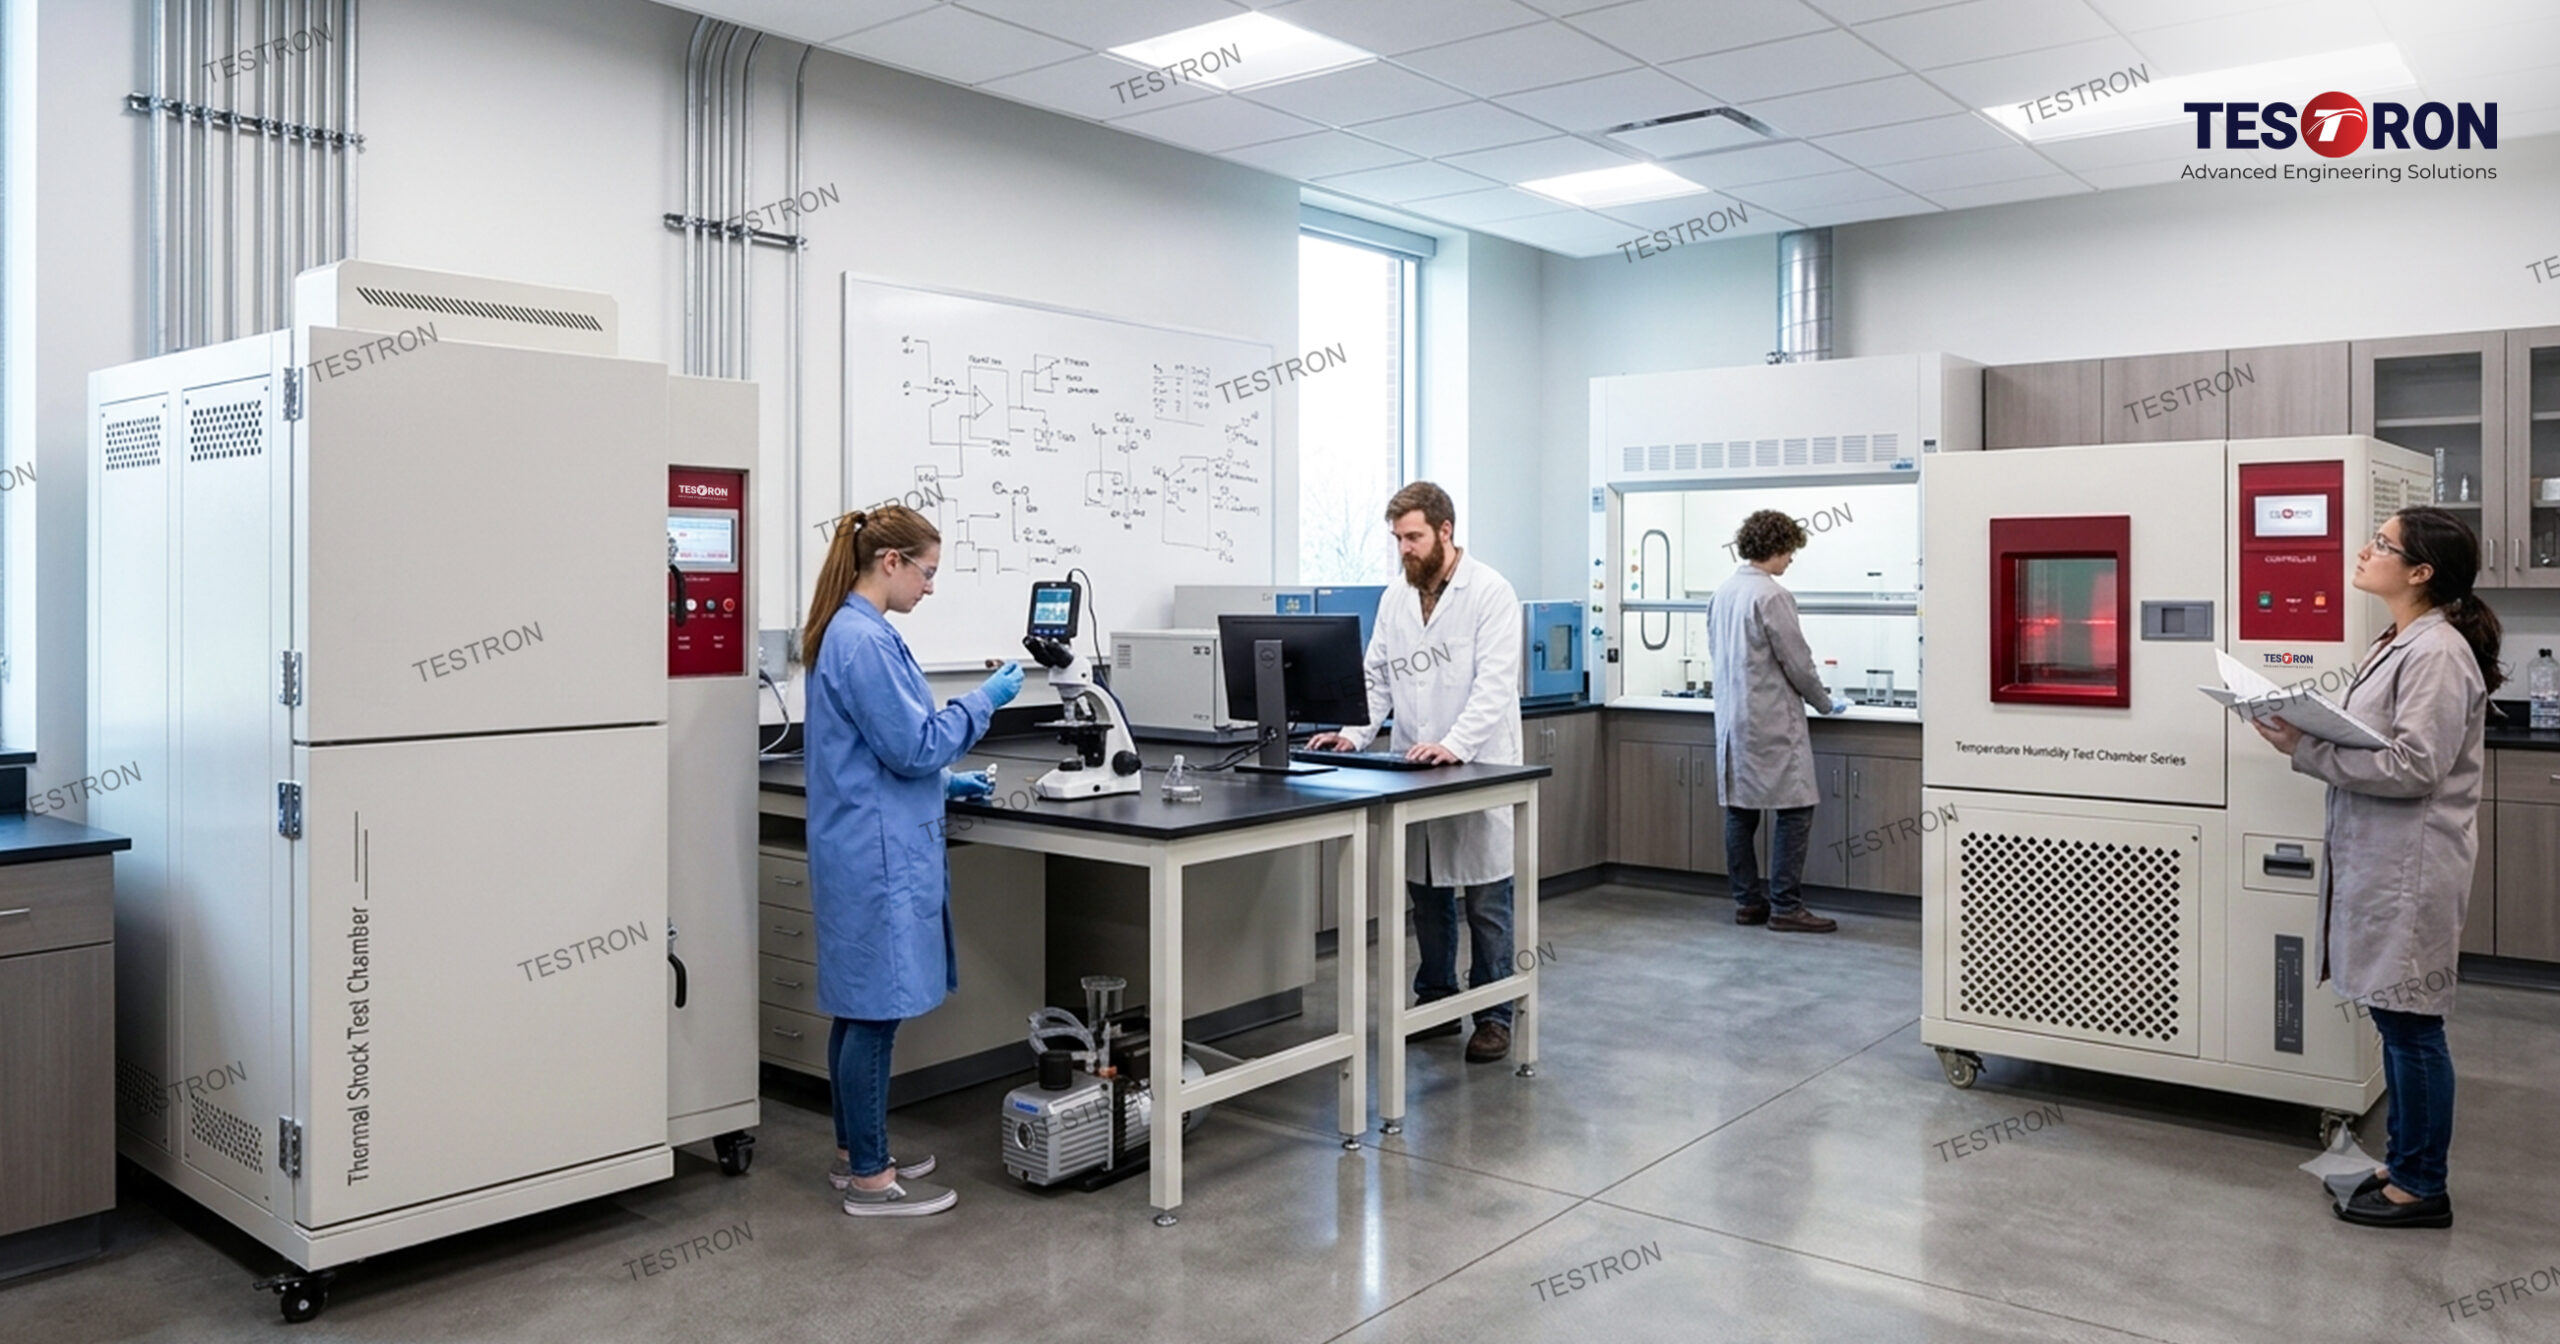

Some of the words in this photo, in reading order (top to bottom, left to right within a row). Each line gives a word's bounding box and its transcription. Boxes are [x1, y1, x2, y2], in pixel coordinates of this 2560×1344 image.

[2264, 652, 2314, 664] TESTRON
[2096, 749, 2148, 763] Chamber
[2150, 752, 2186, 766] Series
[347, 907, 369, 993] Chamber
